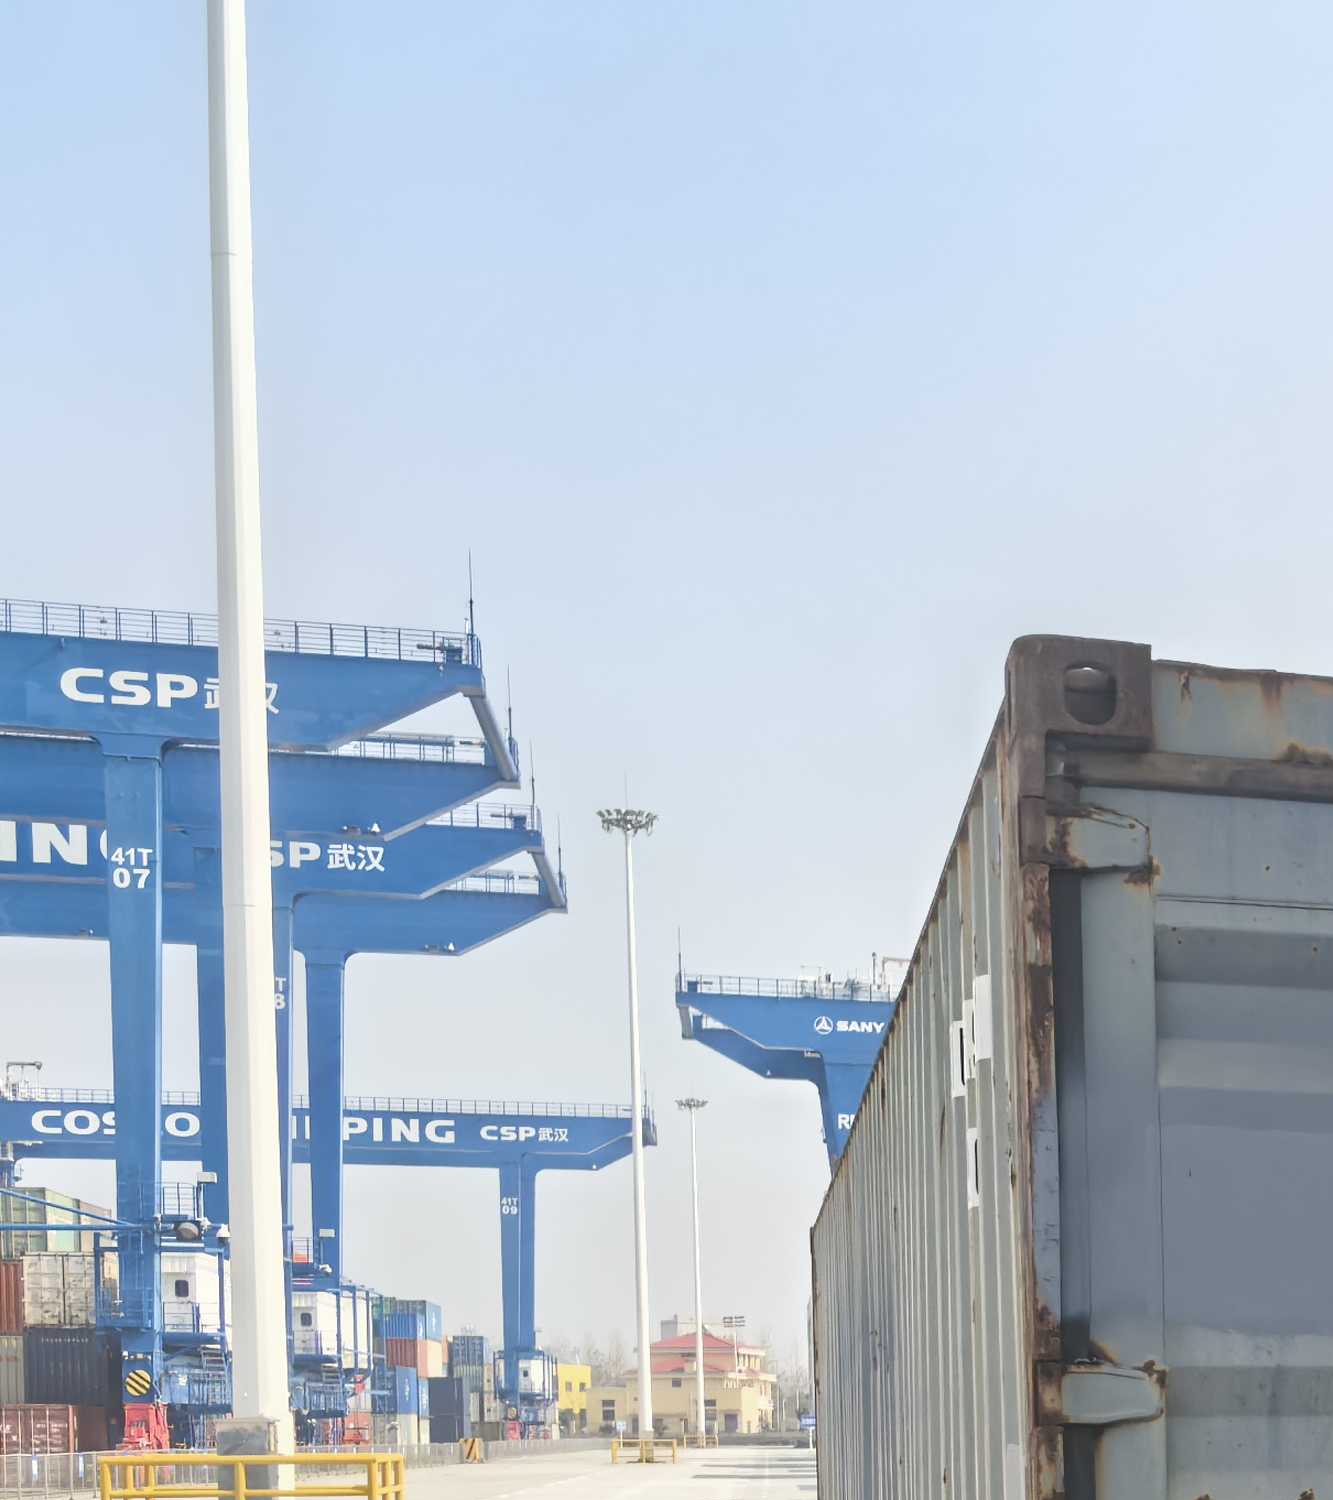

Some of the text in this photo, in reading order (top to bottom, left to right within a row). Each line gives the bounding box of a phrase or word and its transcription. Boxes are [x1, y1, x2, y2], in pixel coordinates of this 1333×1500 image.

[60, 667, 198, 708] CSP
[0, 820, 107, 865] IN
[111, 848, 152, 866] 41T
[270, 840, 385, 872] SP 武汉
[112, 868, 150, 889] 07
[836, 1020, 885, 1033] SANY
[31, 1109, 201, 1138] COO
[480, 1125, 535, 1141] CSP
